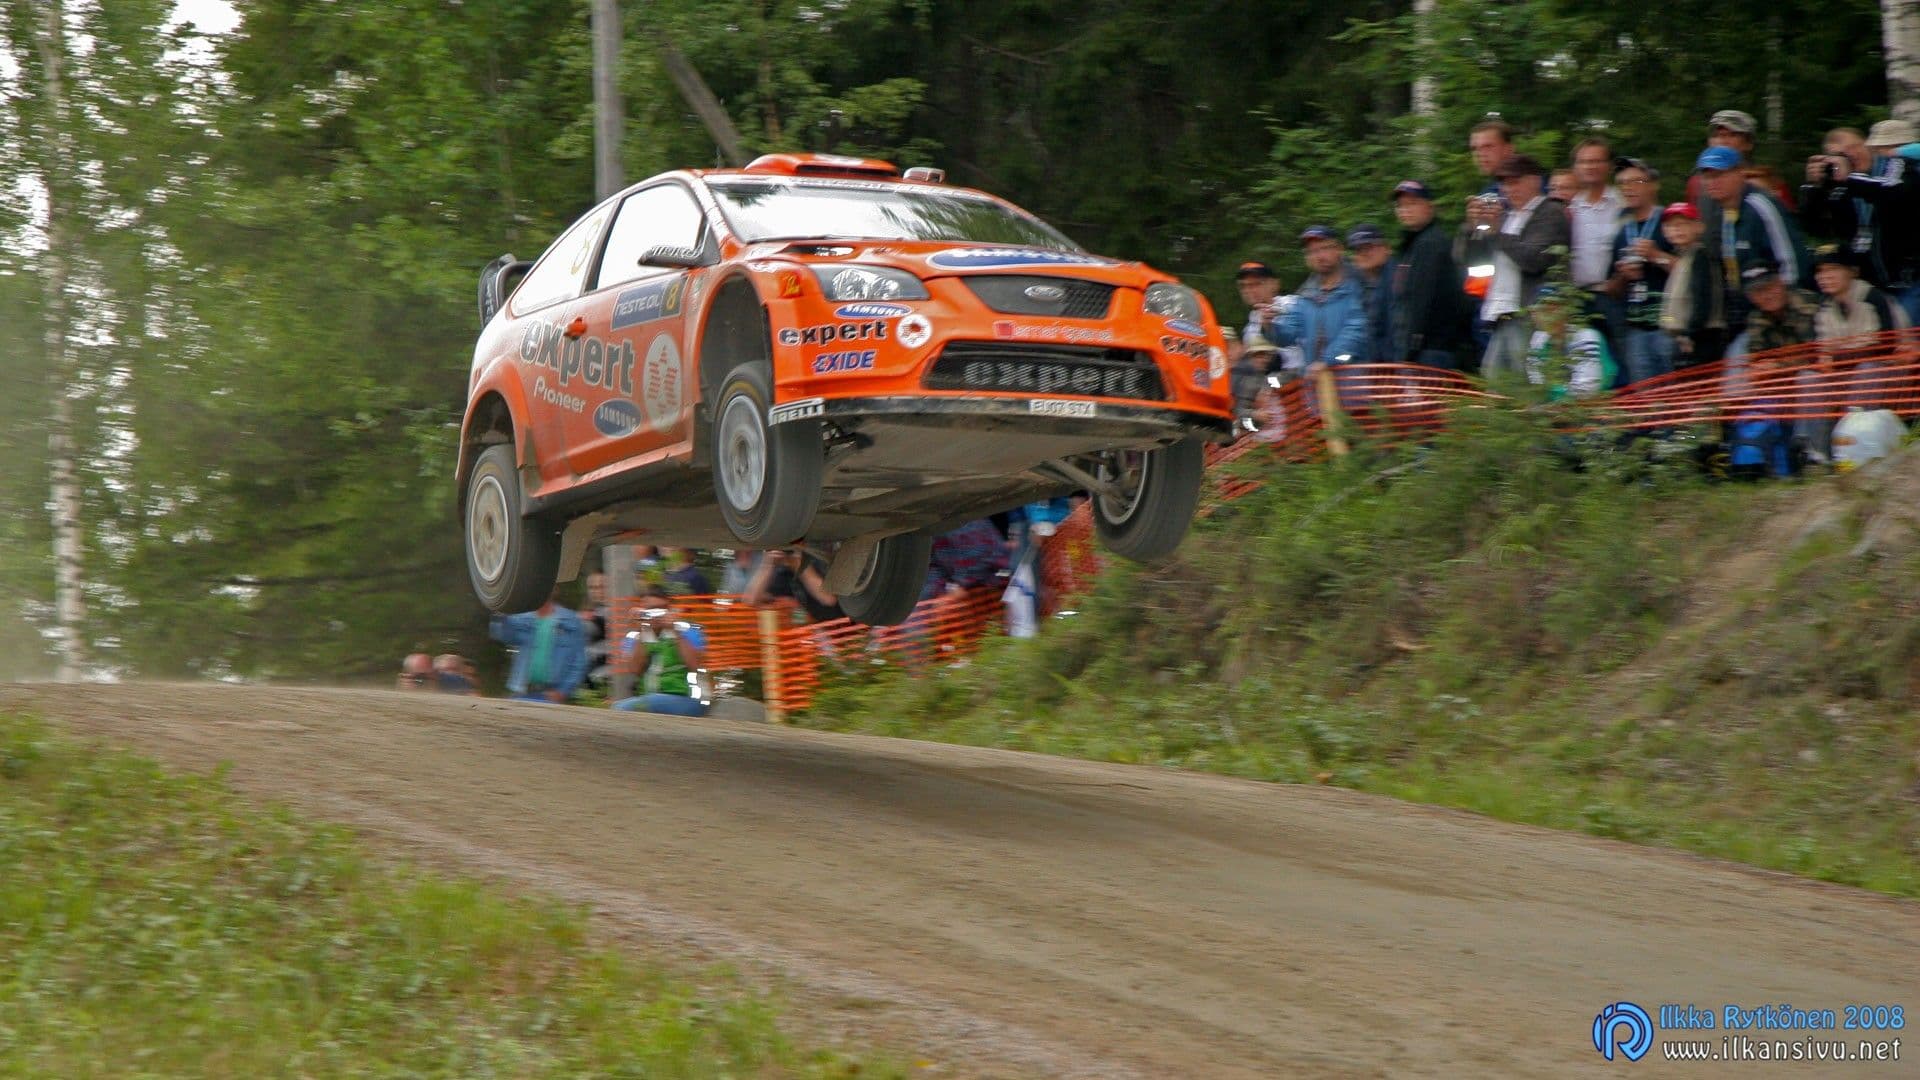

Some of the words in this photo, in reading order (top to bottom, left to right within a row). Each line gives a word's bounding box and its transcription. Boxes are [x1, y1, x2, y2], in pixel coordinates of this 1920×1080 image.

[666, 283, 680, 311] 8
[845, 304, 902, 316] SAMSUNG
[778, 319, 888, 346] expert
[520, 320, 635, 396] expert
[811, 350, 877, 375] EXIDE
[963, 361, 1144, 393] expert
[534, 375, 586, 414] Pioneer
[600, 406, 637, 430] SAMSUNG
[769, 398, 824, 427] PIRELLI
